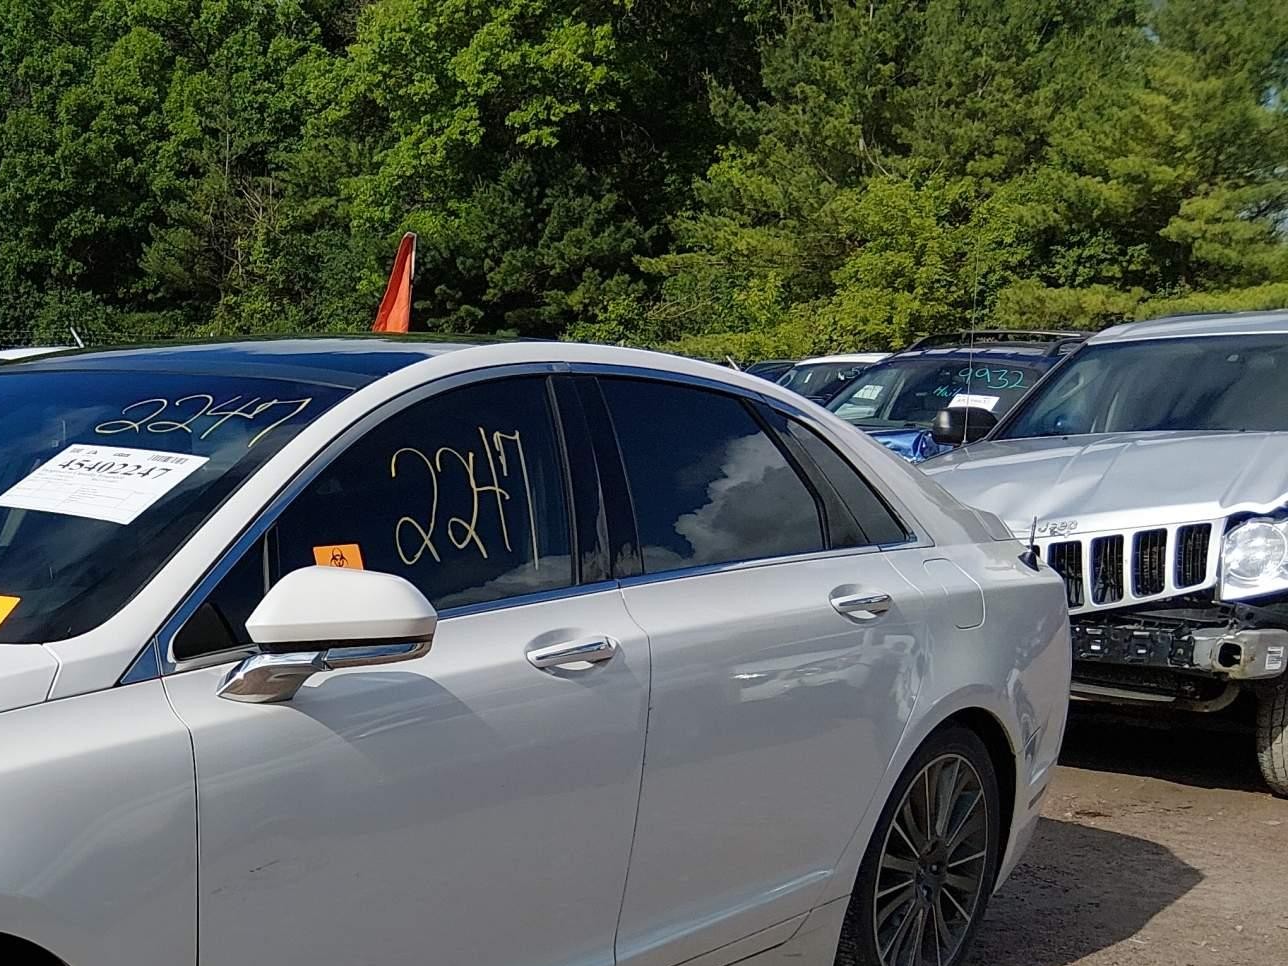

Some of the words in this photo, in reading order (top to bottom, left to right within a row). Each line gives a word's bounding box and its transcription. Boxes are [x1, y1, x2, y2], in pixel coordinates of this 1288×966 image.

[958, 367, 1029, 389] 9932
[95, 394, 312, 448] 2247
[58, 457, 174, 480] 45402247
[391, 426, 539, 570] 2247
